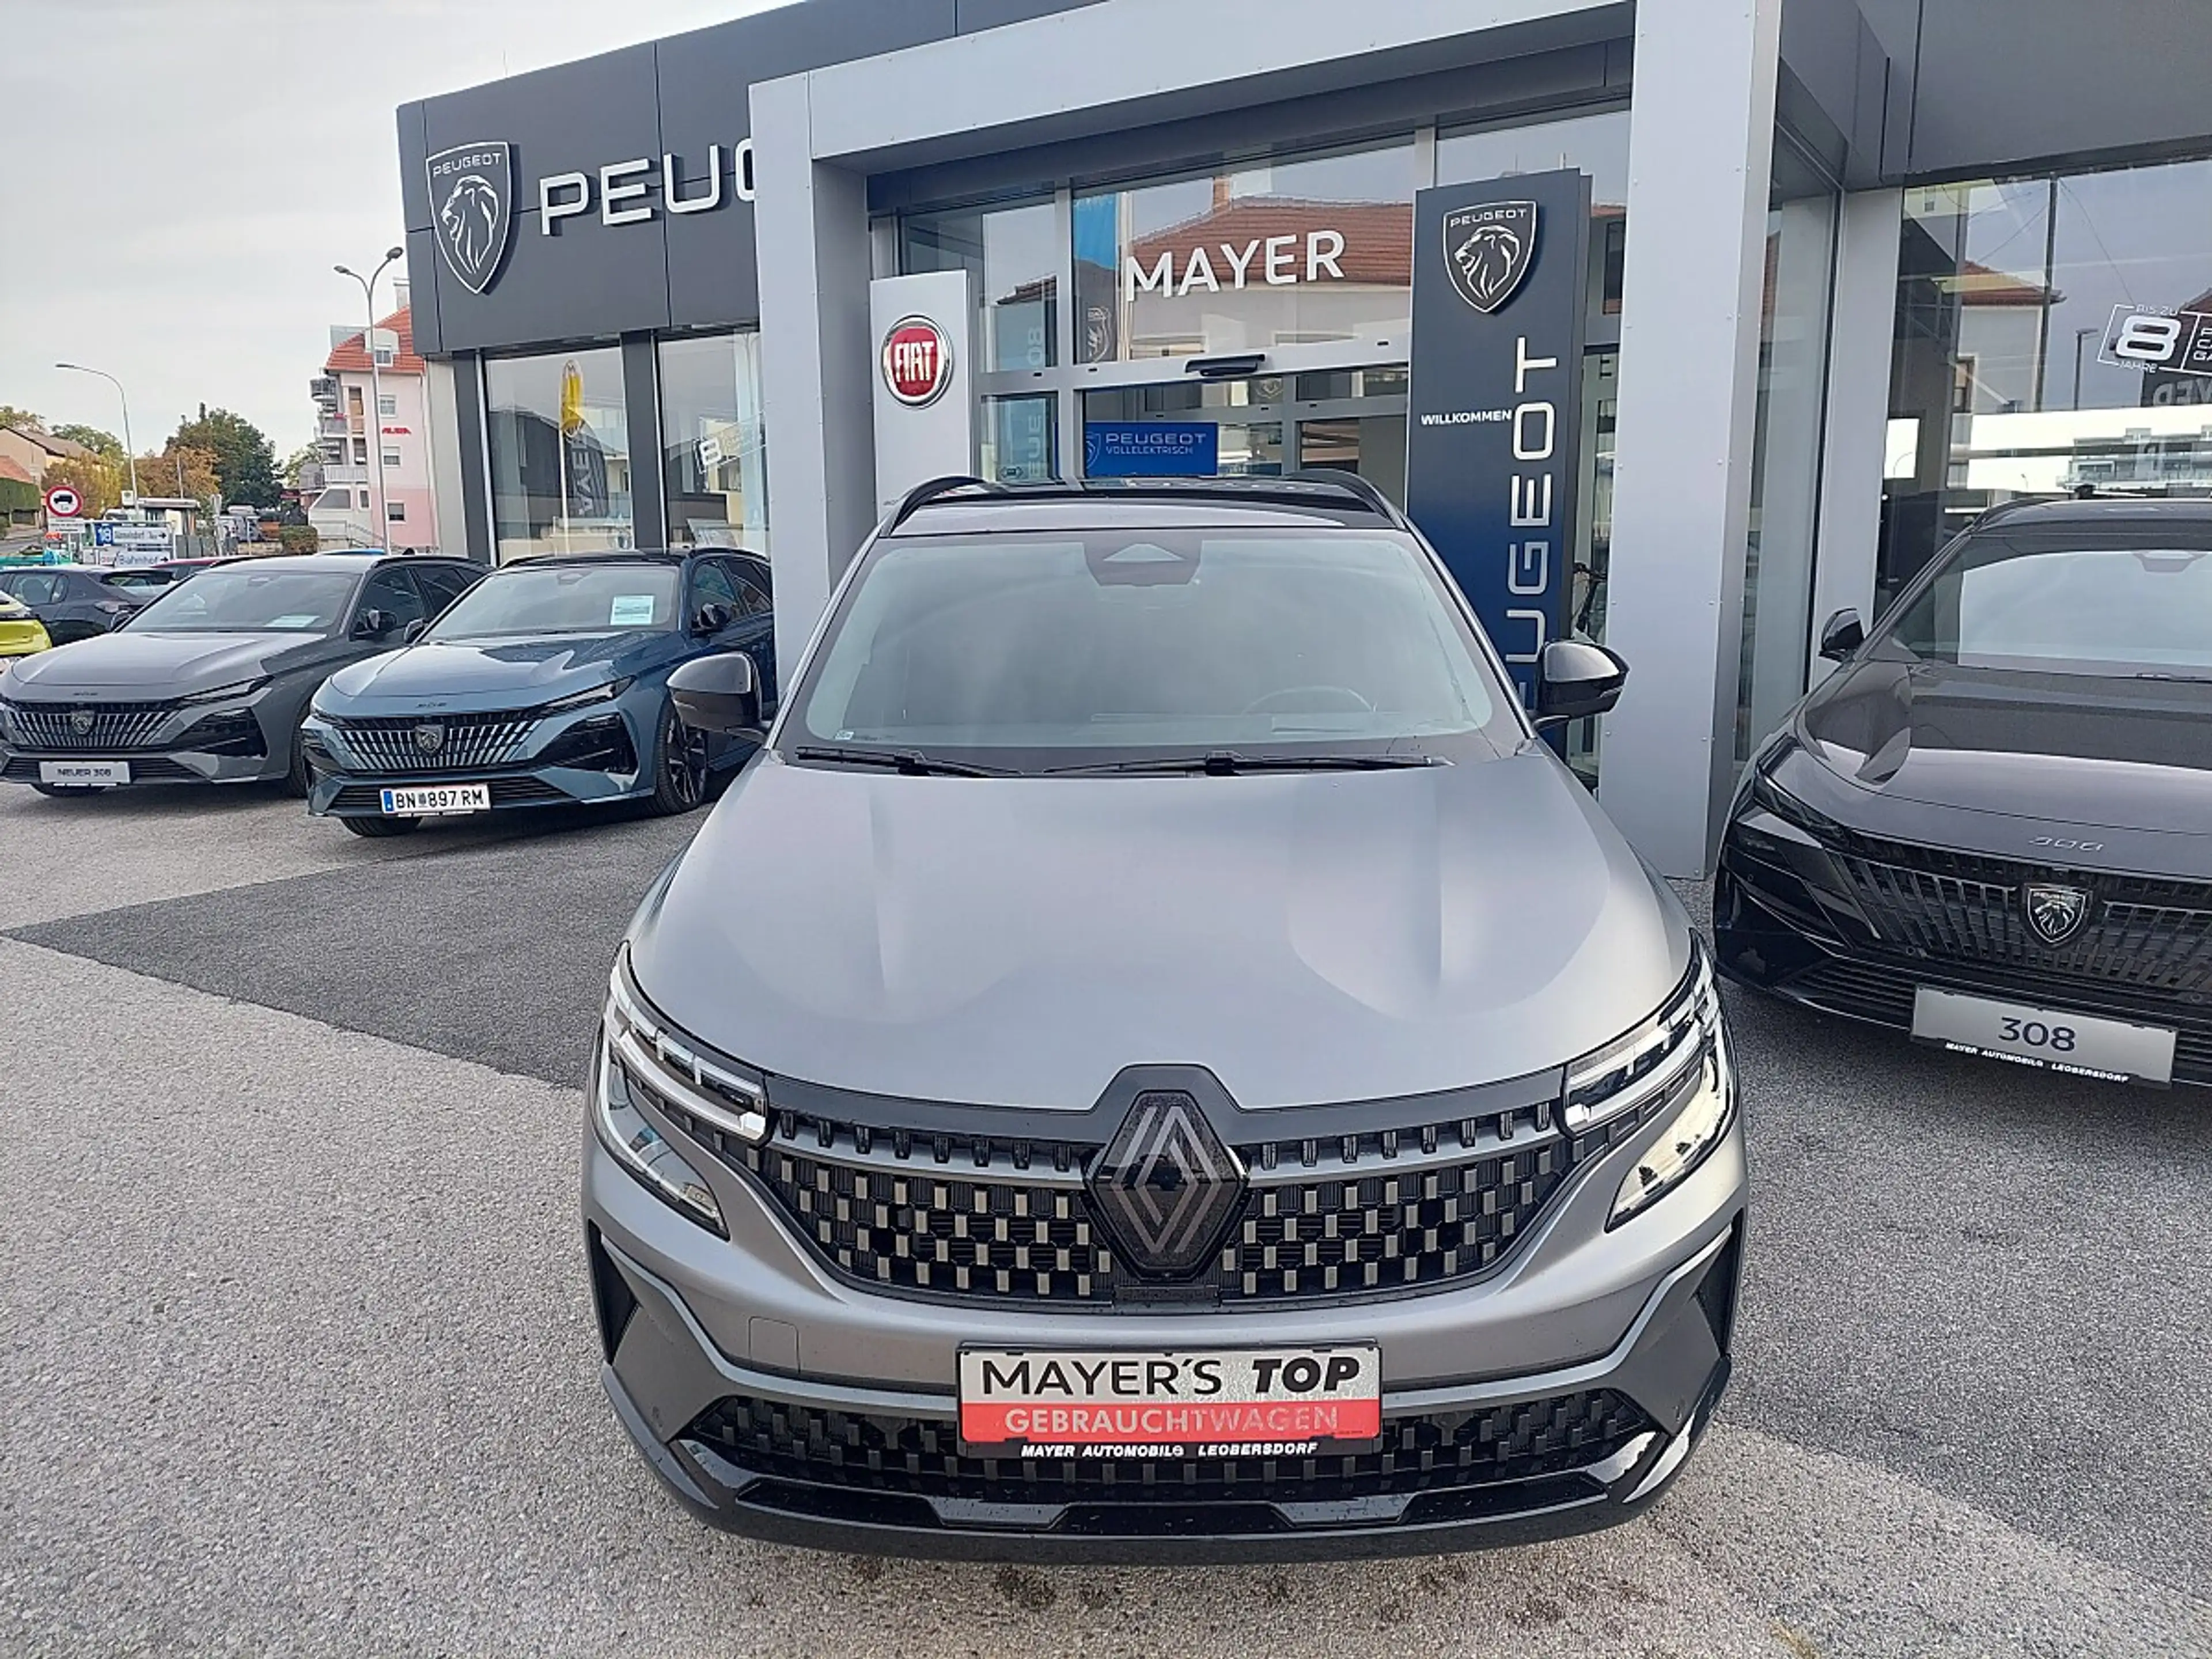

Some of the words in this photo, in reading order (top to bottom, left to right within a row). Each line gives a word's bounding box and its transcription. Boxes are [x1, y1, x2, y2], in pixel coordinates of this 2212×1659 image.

[433, 152, 501, 177] PEUGEOT
[1450, 209, 1527, 228] PEUGEOT
[1126, 230, 1345, 302] MAYER
[2116, 315, 2181, 361] 8
[895, 341, 934, 382] FIAT
[1421, 410, 1512, 425] WILLKOMMEN
[1105, 433, 1207, 445] PEUGEOT
[1105, 446, 1194, 454] VOLLELEKTRISCH
[1505, 336, 1556, 713] UGEOT
[93, 768, 112, 777] 308
[396, 792, 416, 809] BN
[428, 790, 457, 807] 897
[461, 789, 484, 805] RM
[1998, 1016, 2075, 1052] 308
[1945, 1041, 1979, 1055] MAYER
[2051, 1063, 2130, 1083] LEOBERSDORF
[983, 1359, 1222, 1395] MAYER'S
[1252, 1357, 1361, 1393] TOP
[1004, 1406, 1338, 1434] GEBRAUCHTWAGEN
[1021, 1445, 1075, 1458] MAYER
[1198, 1441, 1319, 1457] LEOBERSDORF
